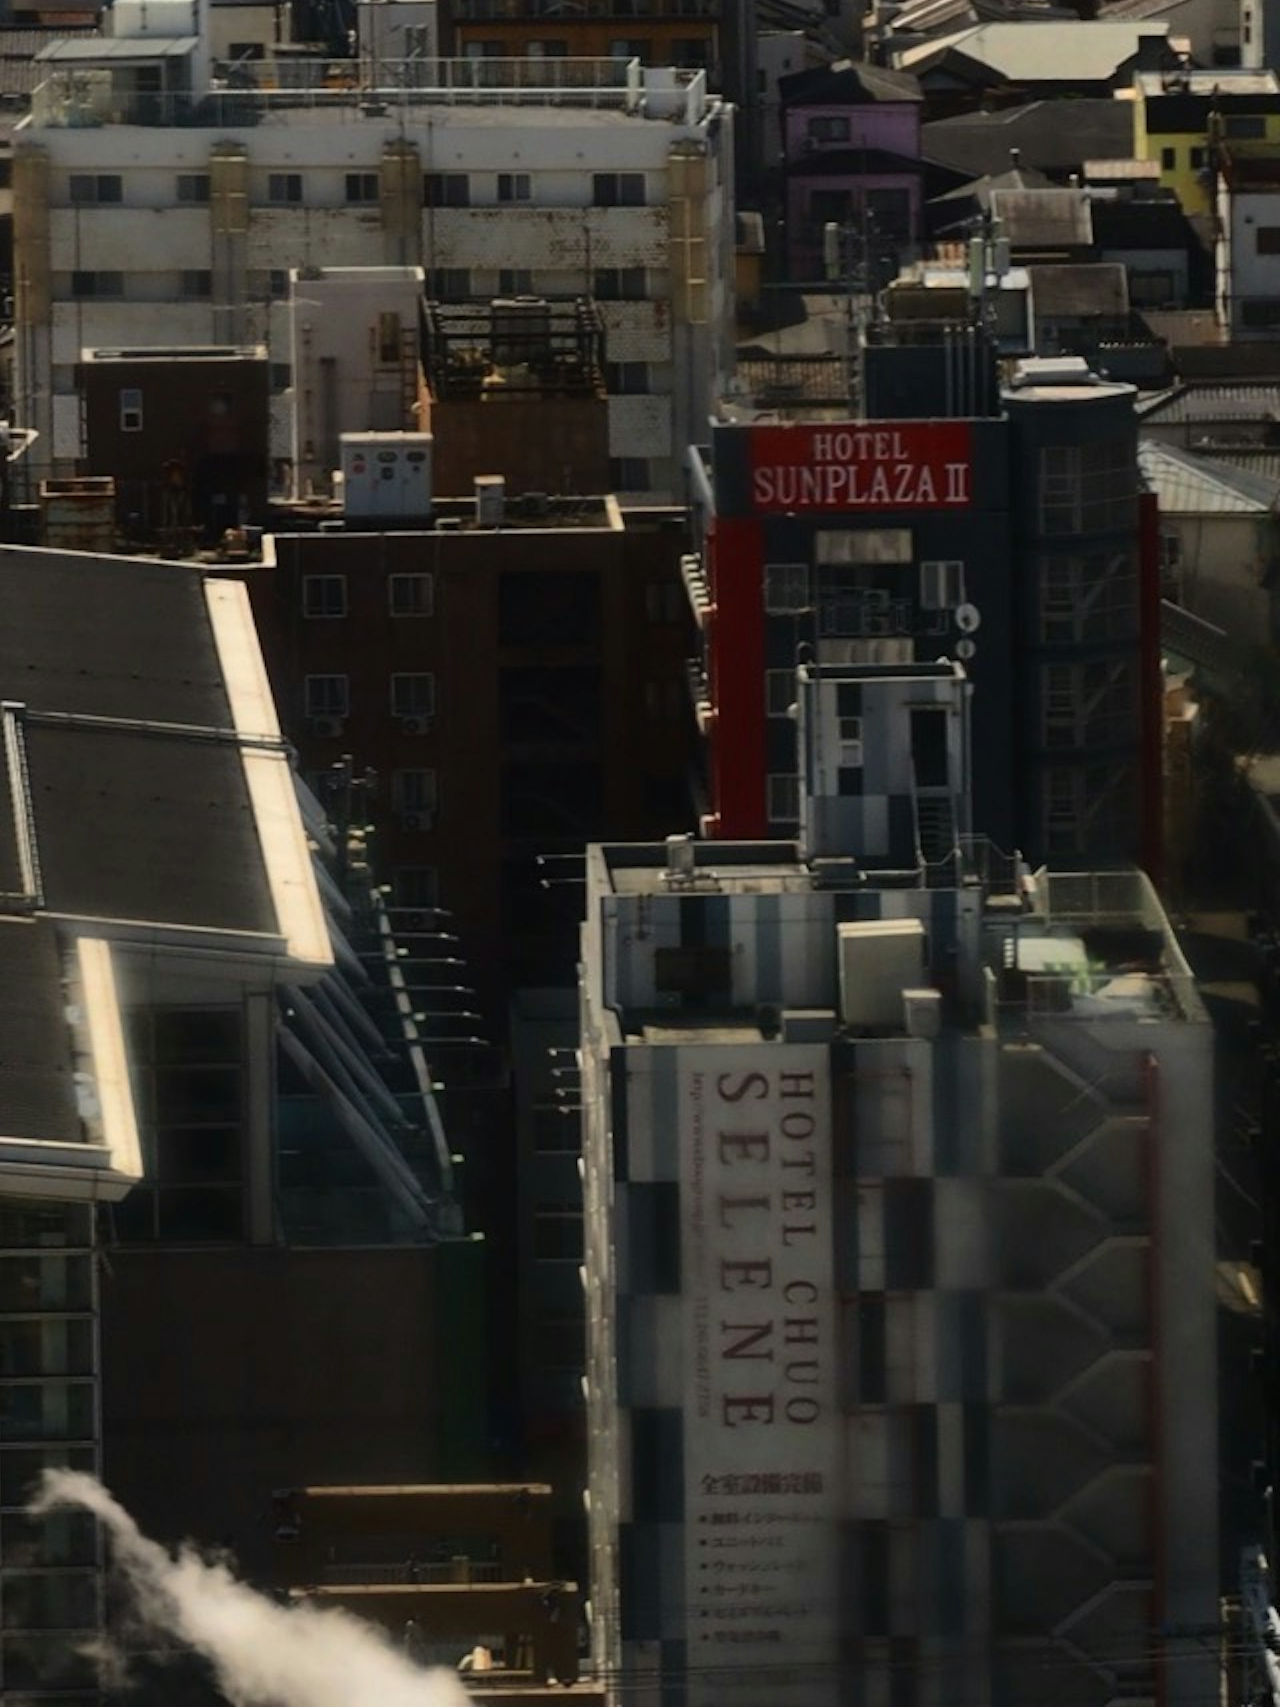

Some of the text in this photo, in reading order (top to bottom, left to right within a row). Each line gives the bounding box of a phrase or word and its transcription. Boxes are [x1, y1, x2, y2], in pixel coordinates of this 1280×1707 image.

[754, 464, 937, 504] SUNPLAZA
[814, 432, 909, 460] HOTEL
[717, 1072, 775, 1428] SELENE
[780, 1072, 820, 1424] HOTEL CHUO
